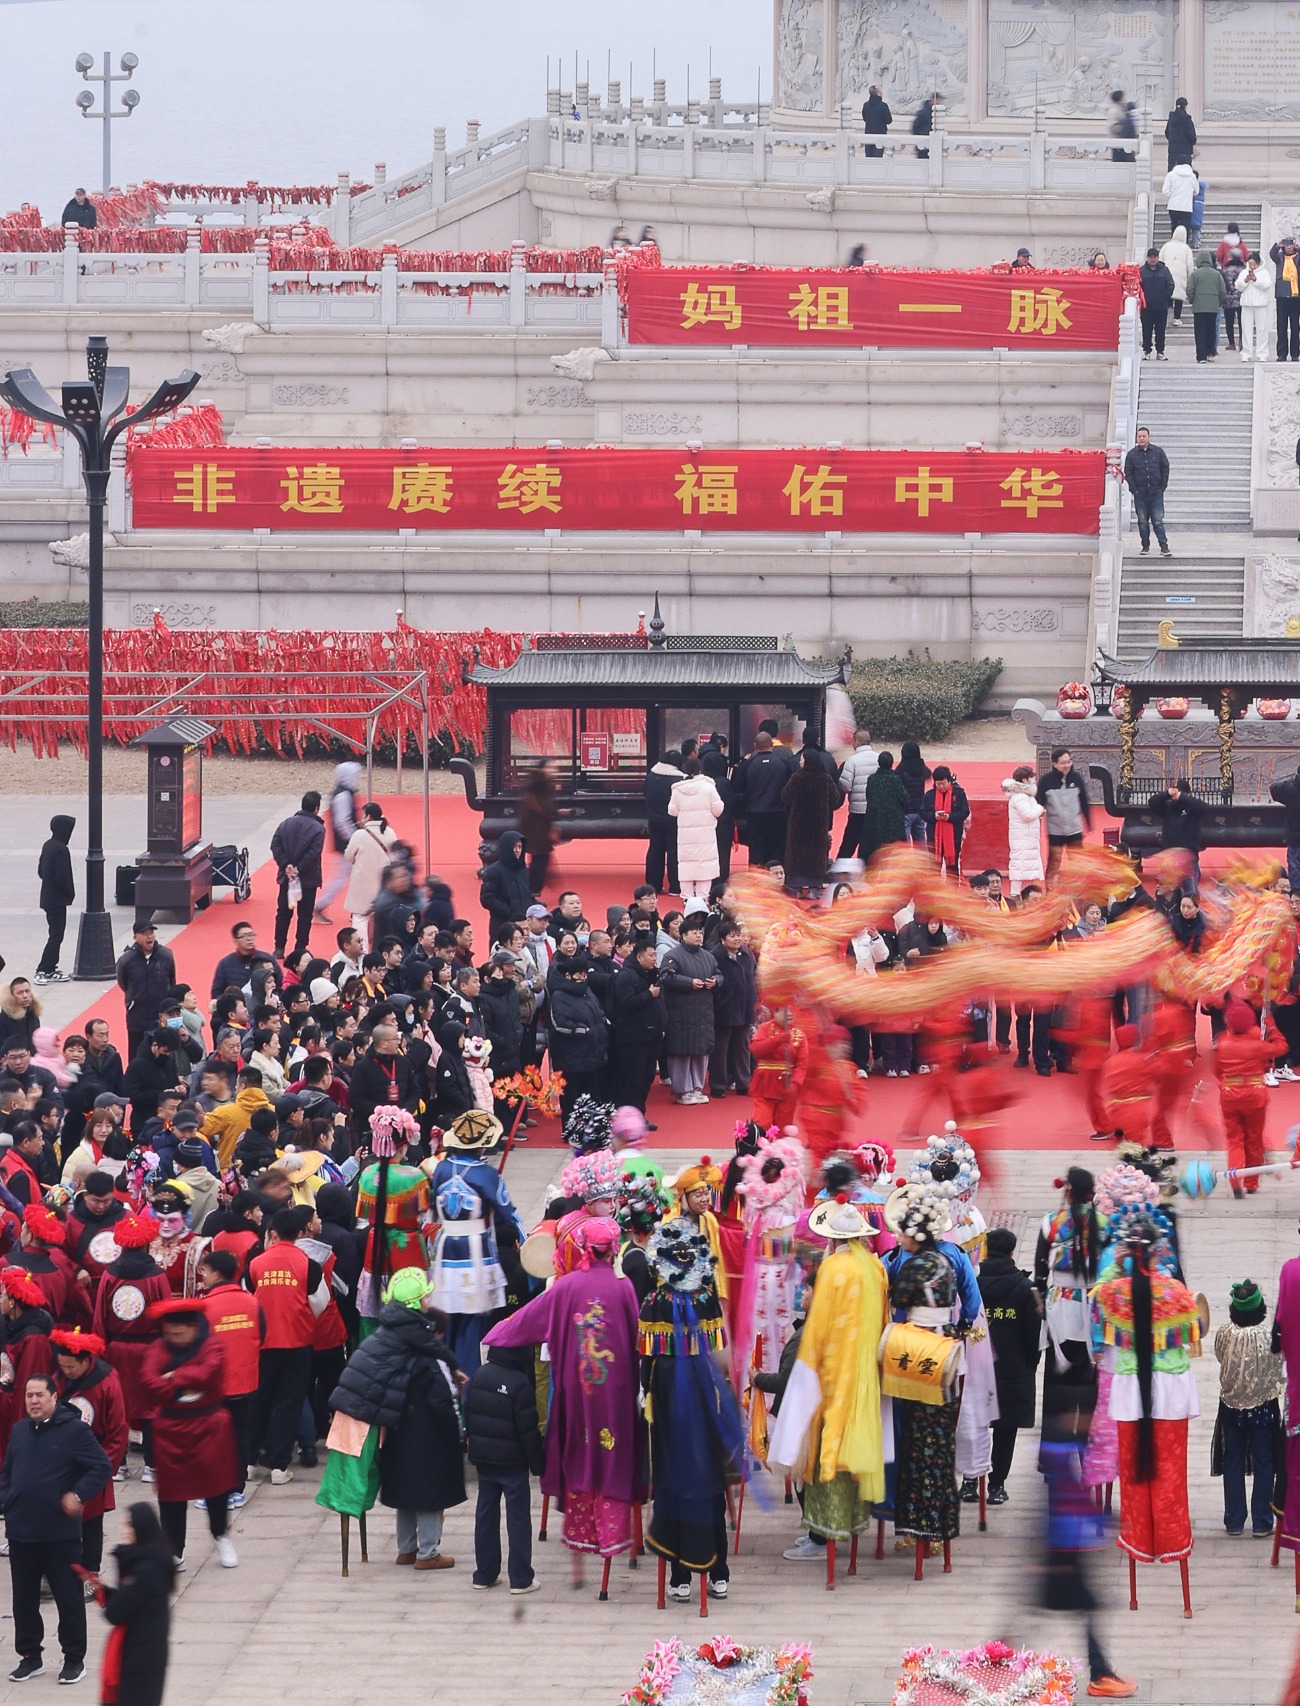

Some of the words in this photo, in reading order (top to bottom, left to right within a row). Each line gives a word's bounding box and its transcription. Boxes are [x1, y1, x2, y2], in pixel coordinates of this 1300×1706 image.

[680, 283, 1073, 335] 妈祖一脉
[172, 463, 562, 514] 非遗赓续
[675, 464, 1064, 518] 福佑中华
